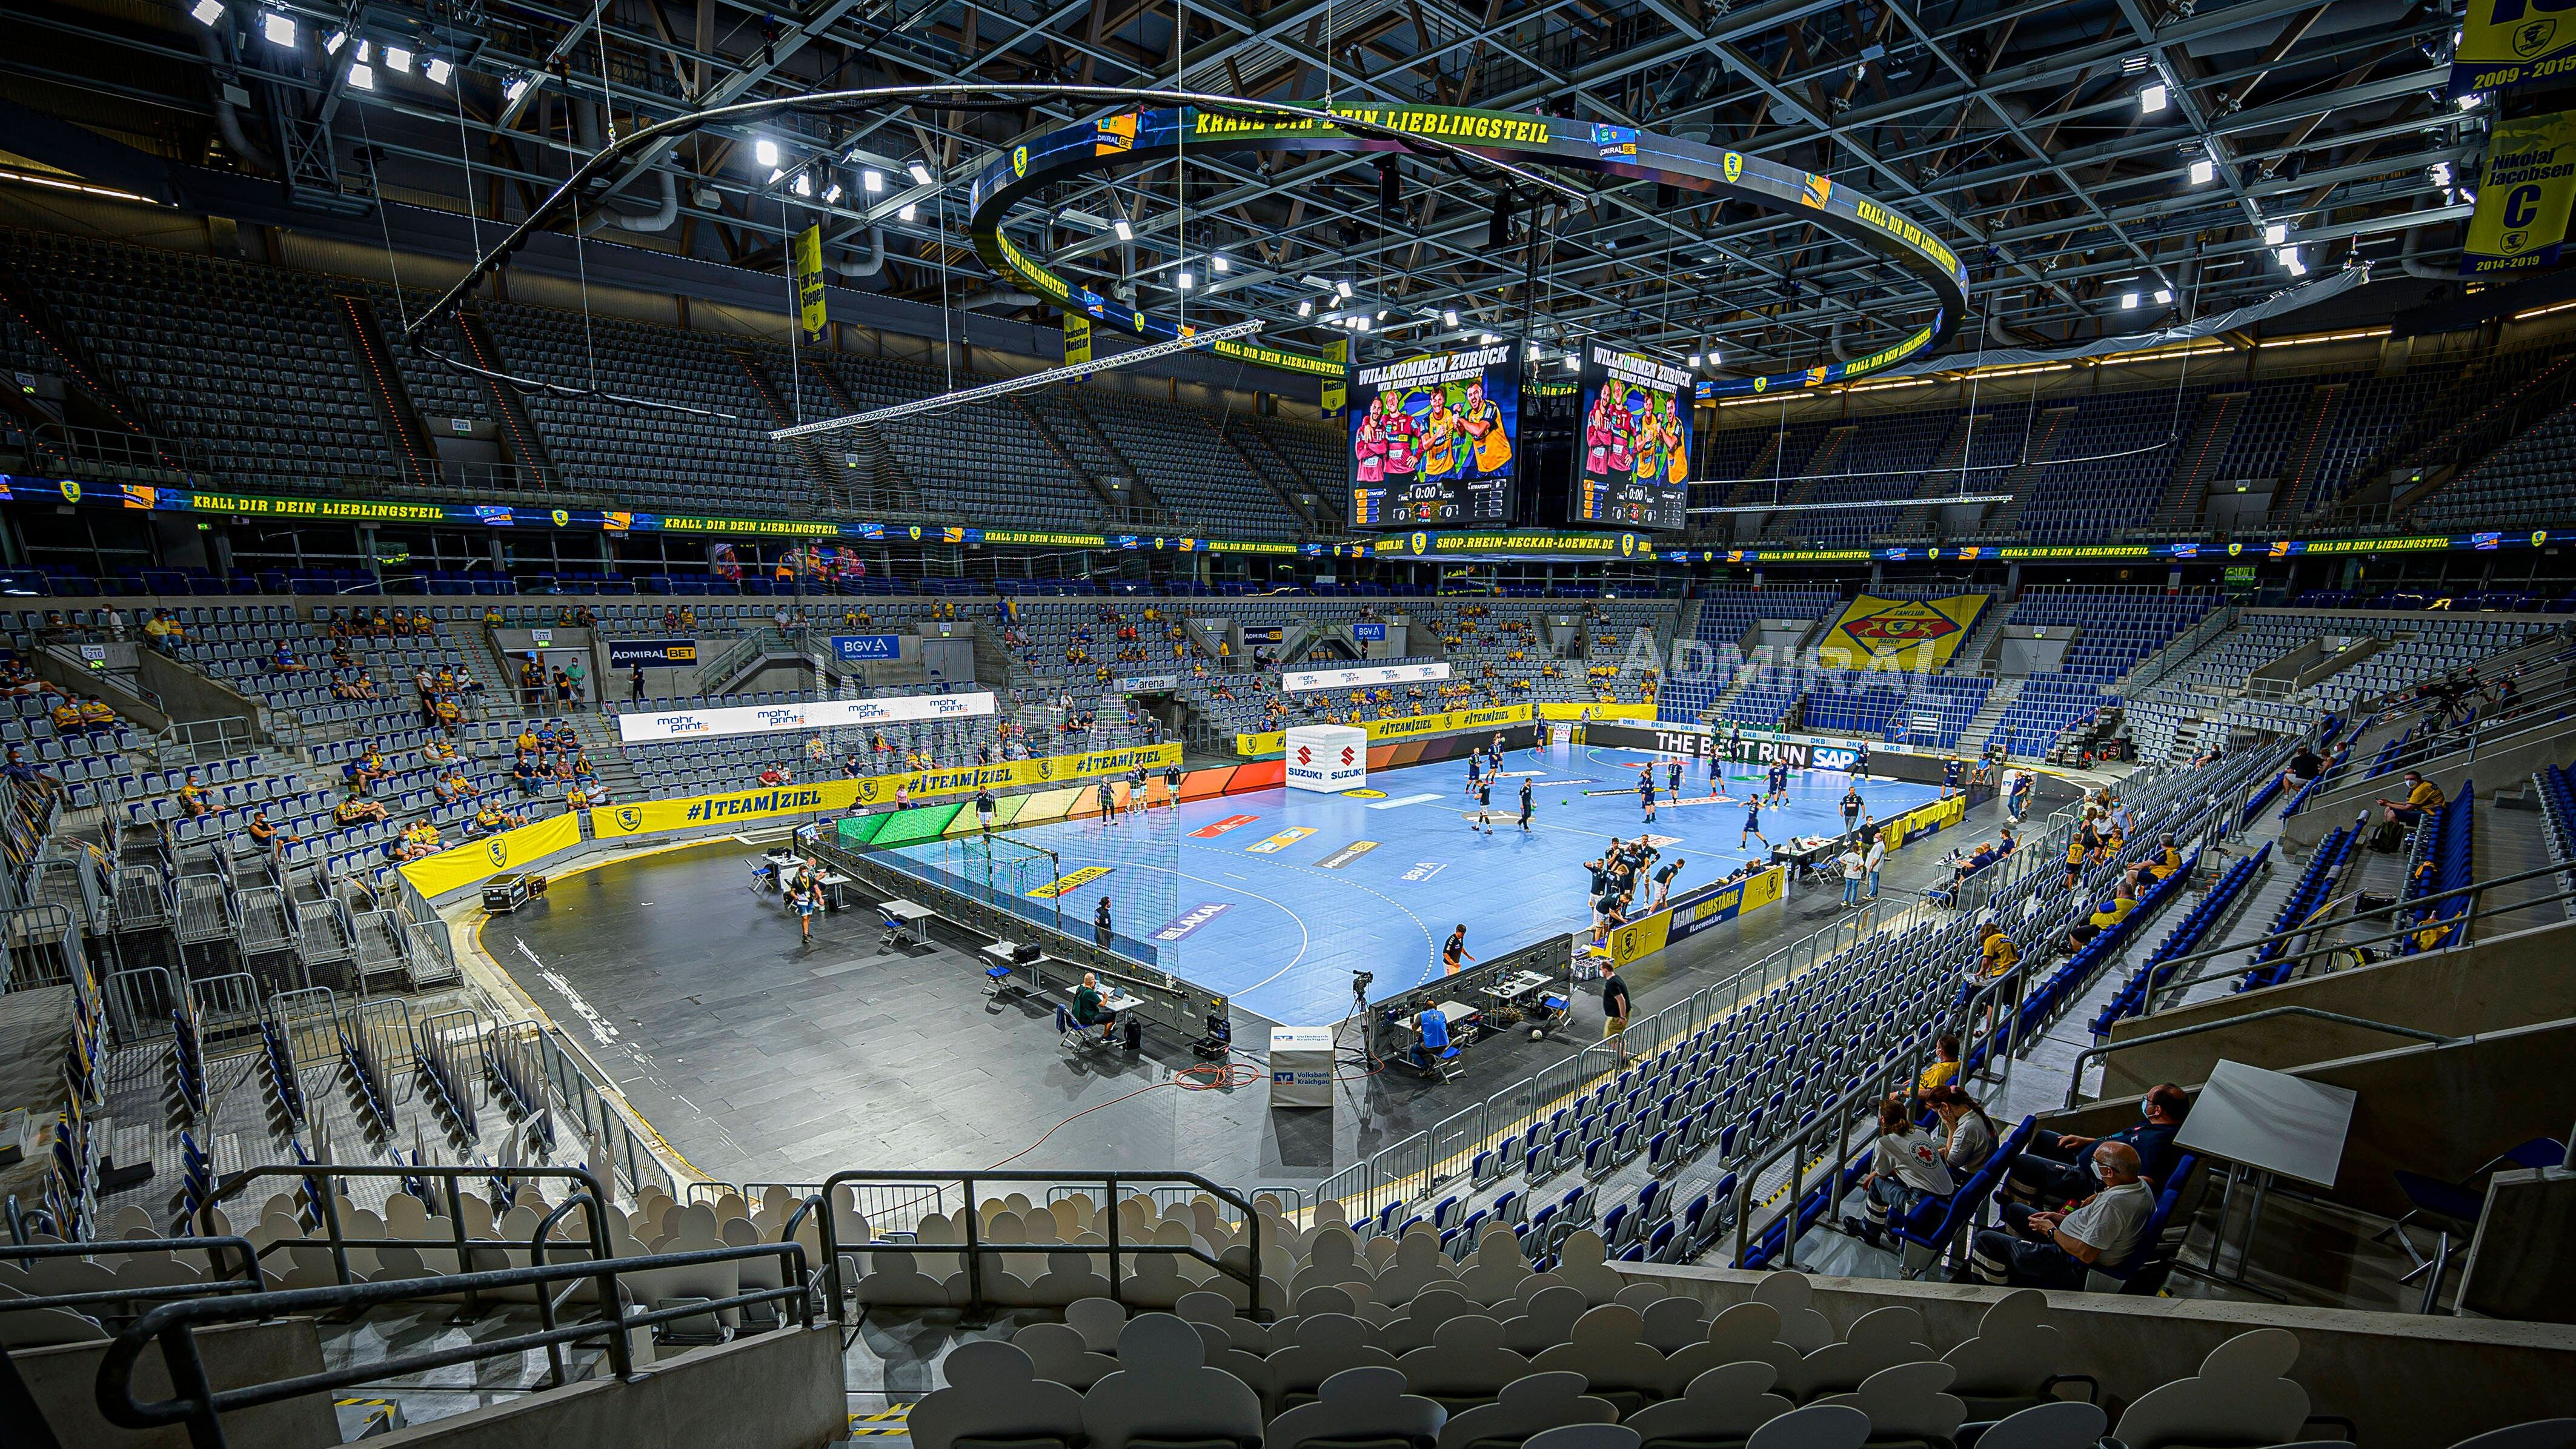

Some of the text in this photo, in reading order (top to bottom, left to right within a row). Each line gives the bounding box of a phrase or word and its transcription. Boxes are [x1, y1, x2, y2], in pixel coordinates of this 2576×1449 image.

[2473, 68, 2518, 90] 2009
[2533, 56, 2576, 78] 2015
[1387, 110, 1549, 144] LIEBLINGSTEIL
[2487, 163, 2575, 187] Jacobsen
[2503, 184, 2542, 228] C
[1858, 201, 1956, 273] KRALL DIR DEIN LIEBLINGSTEIL
[2475, 256, 2540, 271] 2014-2019
[811, 270, 823, 287] Cup
[1009, 245, 1020, 267] DEIN
[1021, 257, 1069, 298] LIEBLINGSTEIL
[802, 287, 824, 308] Sieger
[1066, 339, 1089, 353] Meister
[1847, 328, 1930, 374] KRALL DIR DEIN LIEBLINGSTEIL
[1215, 340, 1346, 375] KRALL DIR DEIN LIEBLINGSTEIL
[1359, 345, 1510, 385] WILLKOMMEN ZURÜCK
[1593, 346, 1692, 388] WILLKOMMEN ZURÜCK
[1418, 374, 1439, 385] EUCH
[1440, 367, 1484, 382] VERMISST!
[1651, 380, 1678, 394] VERMISST!
[1415, 486, 1436, 499] 0:00
[1628, 488, 1644, 501] 0:00
[194, 496, 442, 518] KRALL DIR DEIN LIEBLINGSTEIL
[1446, 507, 1452, 517] 0
[1616, 509, 1621, 520] 0
[1399, 510, 1405, 520] 0
[1648, 511, 1652, 522] 0
[665, 519, 837, 534] KRALL DIR DEIN LIEBLINGSTEIL
[1051, 536, 1104, 545] LIEBLINGSTEIL
[1436, 537, 1615, 549] SHOP.RHEIN-NECKAR-LOEWEN.DE
[2377, 539, 2448, 549] LIEBLINGSTEIL
[844, 640, 872, 652] BGV
[1139, 680, 1164, 689] arena
[848, 703, 878, 713] mohr
[929, 698, 957, 708] mohr
[657, 715, 694, 726] mohr
[757, 709, 792, 719] mohr
[1656, 731, 1696, 754] THE
[1759, 743, 1807, 766] RUN
[1813, 750, 1854, 771] SAP
[1288, 768, 1323, 780] SUZUKI
[1330, 768, 1364, 780] SUZUKI
[1672, 889, 1739, 930] MANNHEIMSTÄRKE
[1168, 905, 1227, 932] LAKAL
[1689, 915, 1722, 933] #LoewenLive
